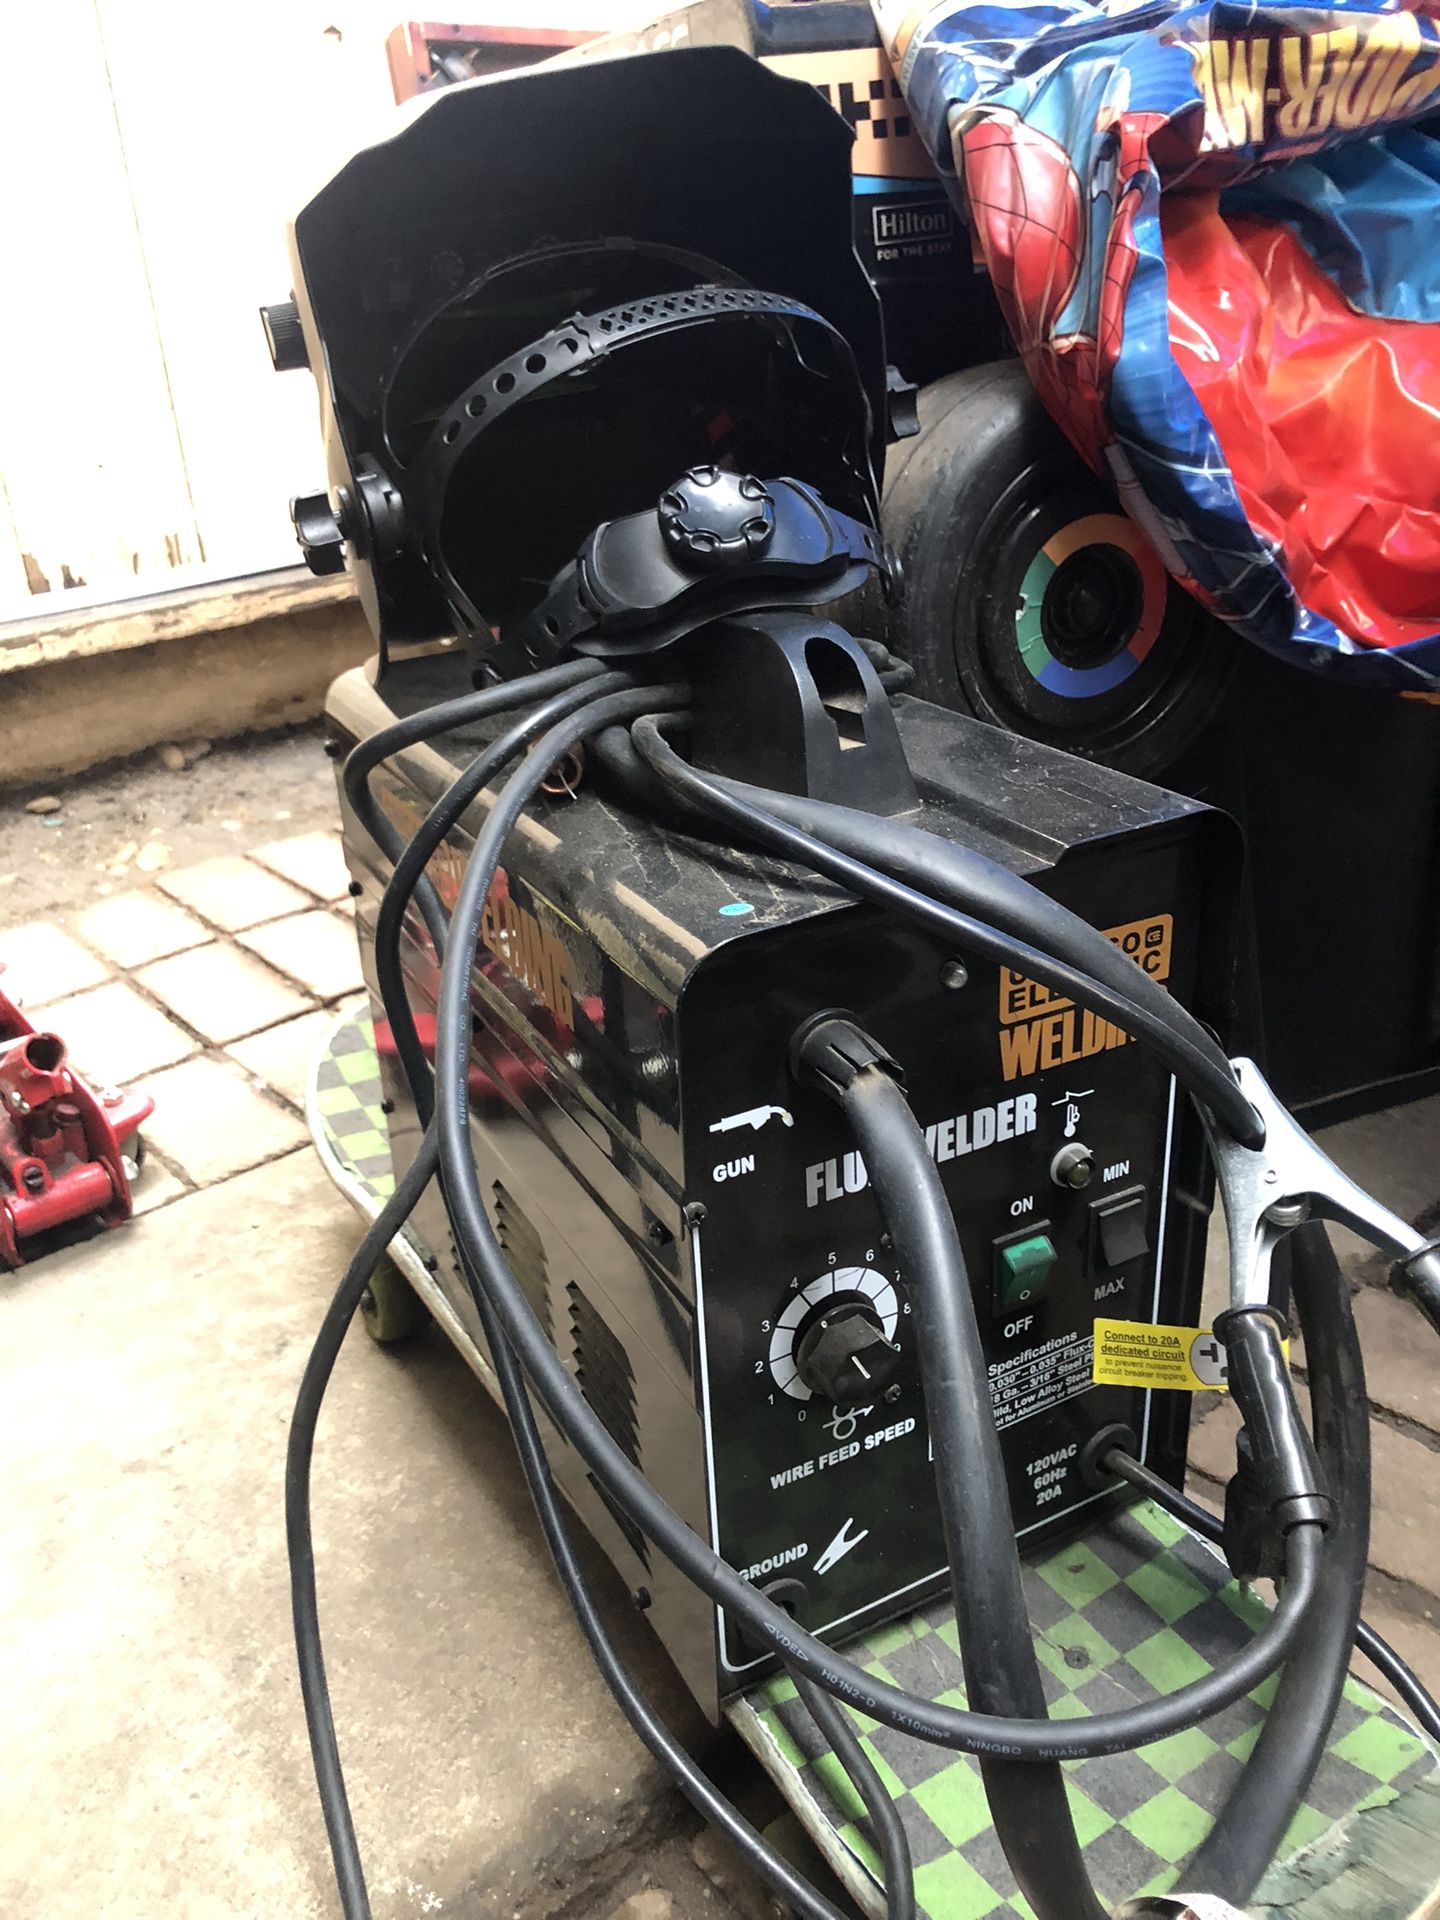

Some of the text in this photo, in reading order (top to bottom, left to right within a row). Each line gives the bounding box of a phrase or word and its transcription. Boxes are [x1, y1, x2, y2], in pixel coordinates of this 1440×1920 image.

[881, 212, 946, 237] Hilton
[877, 248, 899, 261] FOR
[903, 245, 922, 257] THE
[713, 1155, 755, 1183] GUN
[805, 1151, 873, 1208] FLU
[1103, 1160, 1130, 1182] MIN
[1010, 1196, 1034, 1216] ON
[828, 1252, 837, 1265] 5
[865, 1249, 875, 1262] 6
[790, 1277, 799, 1289] 4
[894, 1270, 901, 1282] 7
[1094, 1276, 1125, 1301] MAX
[761, 1320, 771, 1333] 3
[1004, 1315, 1034, 1338] OFF
[1104, 1330, 1181, 1346] Connect to 20A
[988, 1332, 1077, 1376] Specifications
[1063, 1340, 1094, 1359] Flux-C
[1101, 1344, 1185, 1360] dedicated circuit
[754, 1361, 764, 1374] 2
[1099, 1367, 1122, 1376] circuit
[1124, 1369, 1154, 1379] breaker
[1114, 1360, 1143, 1368] prevent
[1145, 1362, 1182, 1371] nuisance
[1003, 1387, 1020, 1399] Ga.
[1057, 1357, 1082, 1375] Steel
[768, 1394, 775, 1405] 1
[994, 1368, 1090, 1419] ild, Low Alloy Steel
[798, 1410, 807, 1422] 0
[1004, 1410, 1017, 1421] for
[1017, 1394, 1056, 1416] Aluminum
[1056, 1390, 1065, 1399] or
[770, 1417, 916, 1490] WIRE FEED SPEED
[1026, 1443, 1077, 1476] 120VAC
[1033, 1466, 1067, 1490] 60Hz
[1036, 1484, 1062, 1506] 20A
[739, 1543, 809, 1582] GROUND
[821, 1668, 876, 1708] H01N2-D
[966, 1738, 1022, 1756] NINGBO
[1038, 1746, 1088, 1757] HUANG
[1105, 1743, 1127, 1751] TAI
